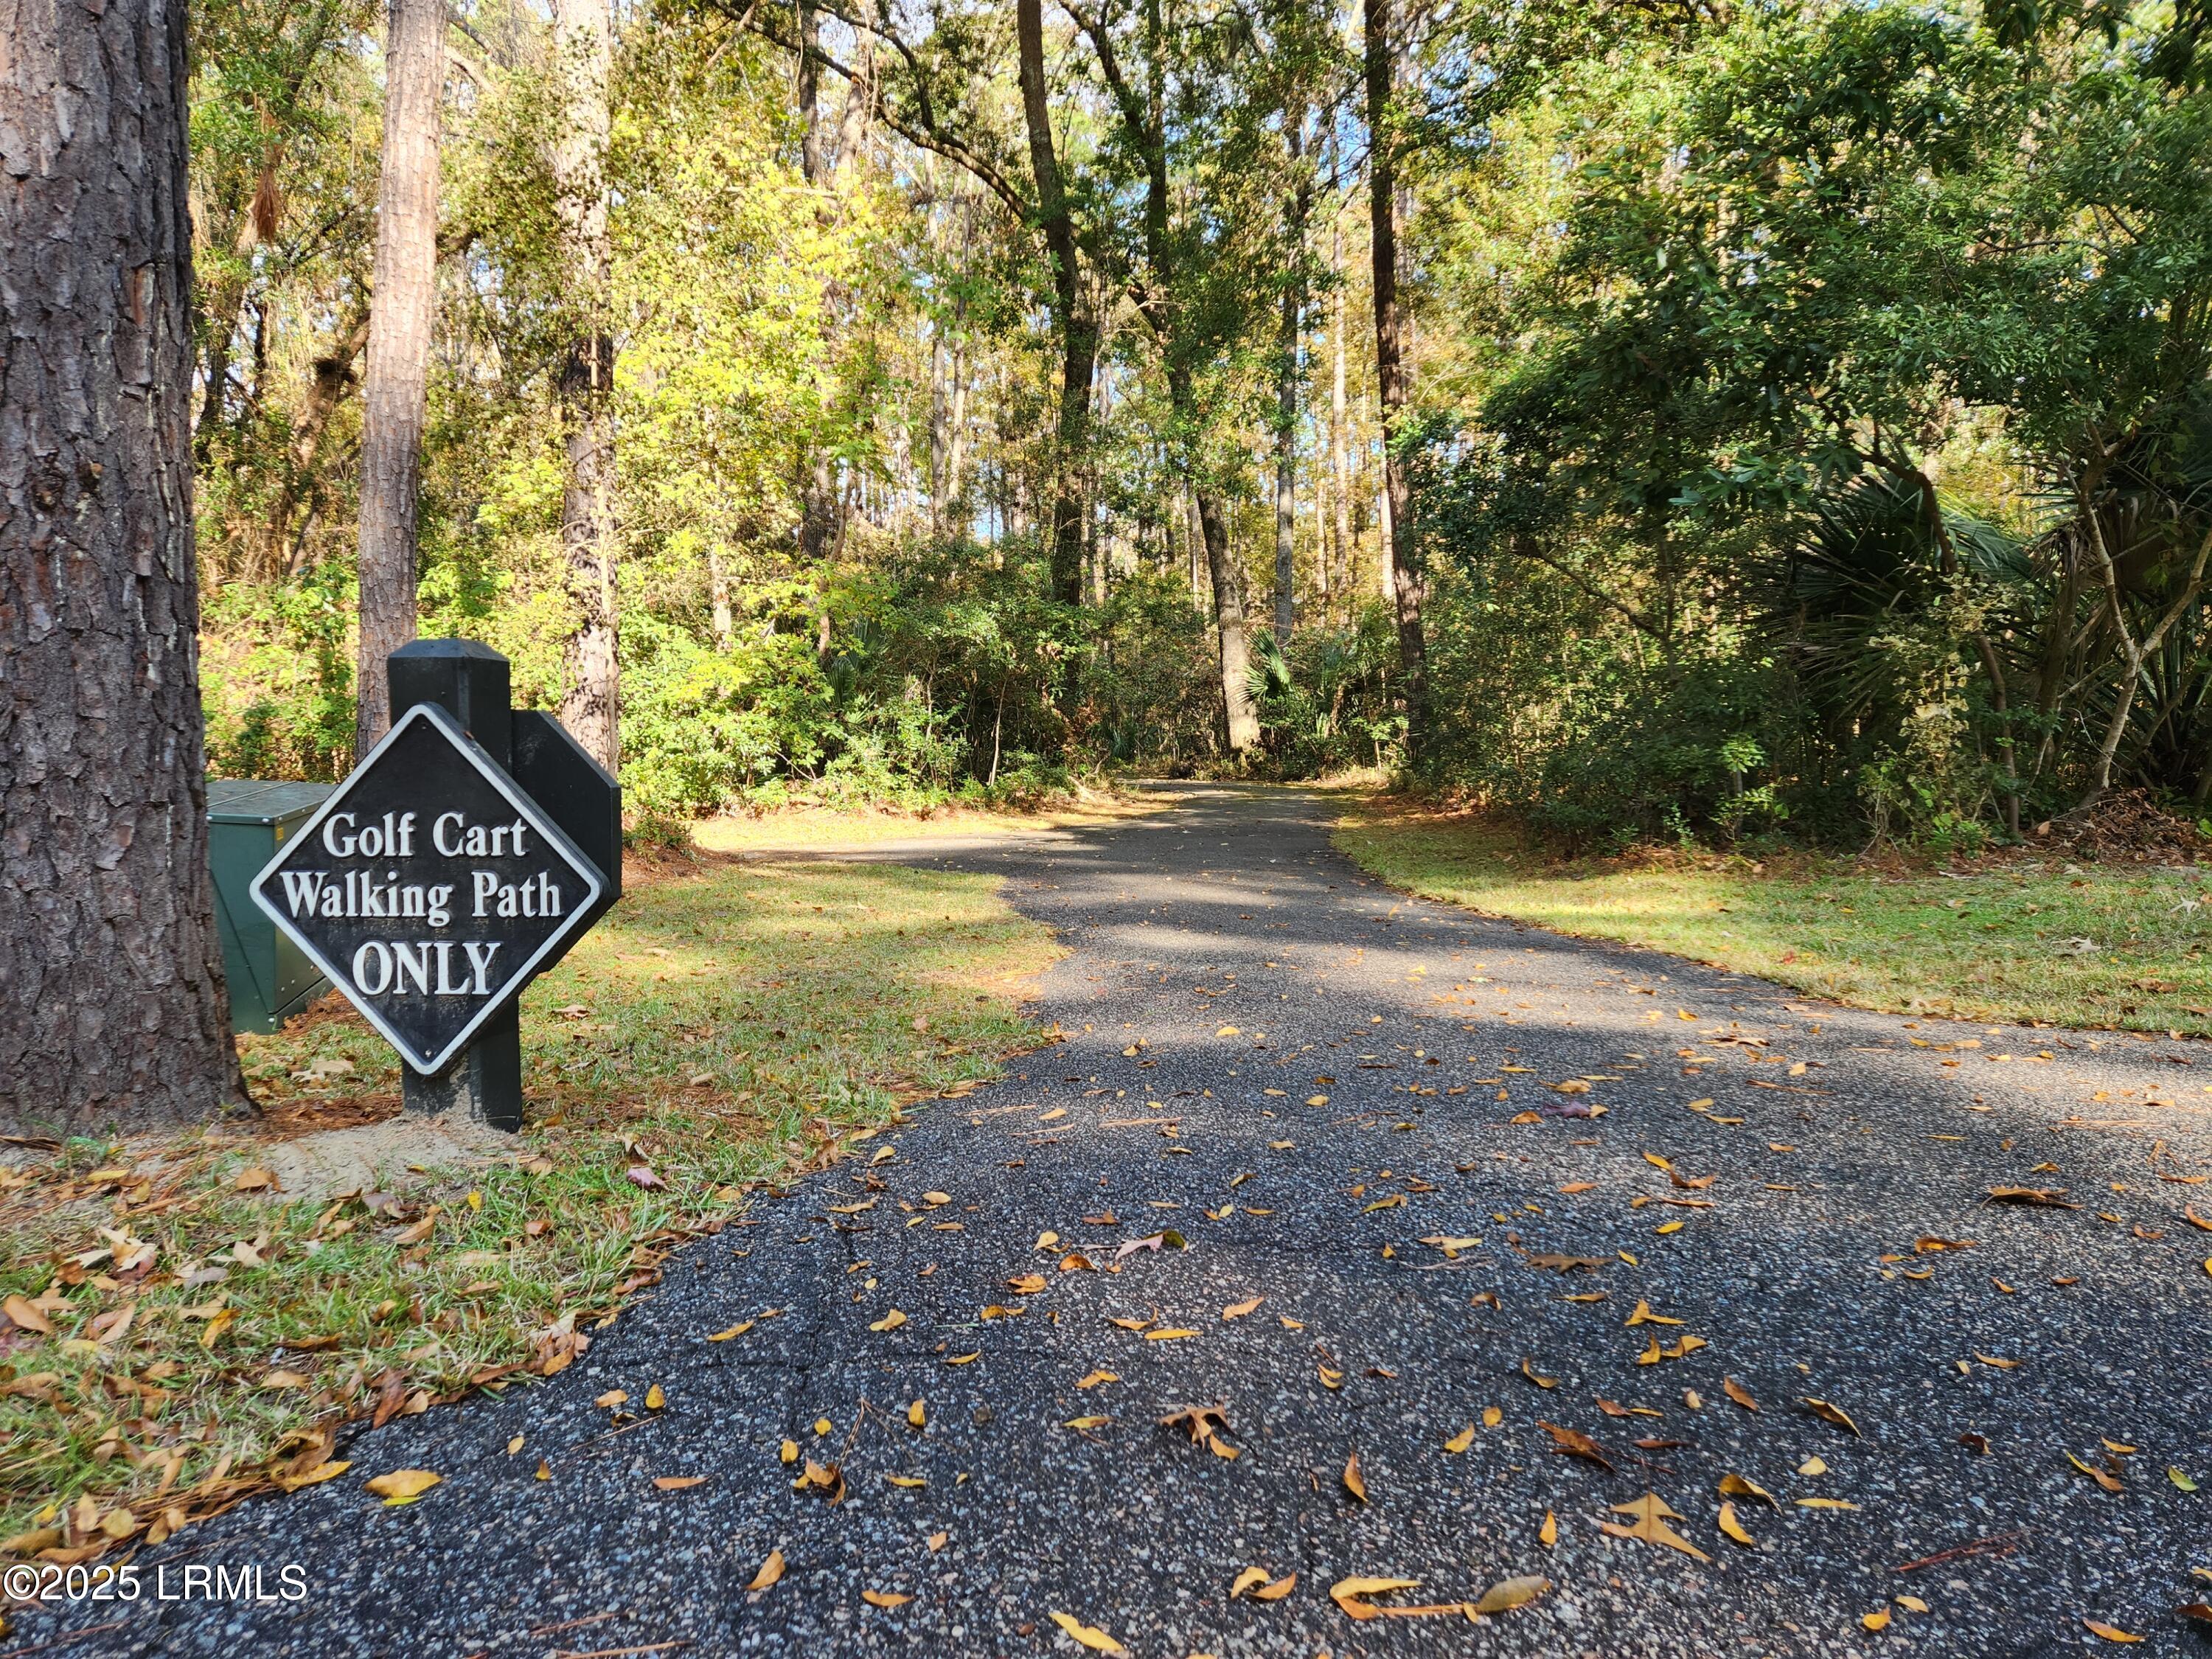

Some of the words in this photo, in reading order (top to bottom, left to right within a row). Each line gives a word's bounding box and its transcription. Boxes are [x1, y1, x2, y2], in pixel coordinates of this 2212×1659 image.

[322, 812, 417, 858] Golf
[433, 812, 527, 858] Cart
[279, 871, 453, 928] Walking
[471, 869, 561, 917] Path
[352, 941, 501, 996] ONLY
